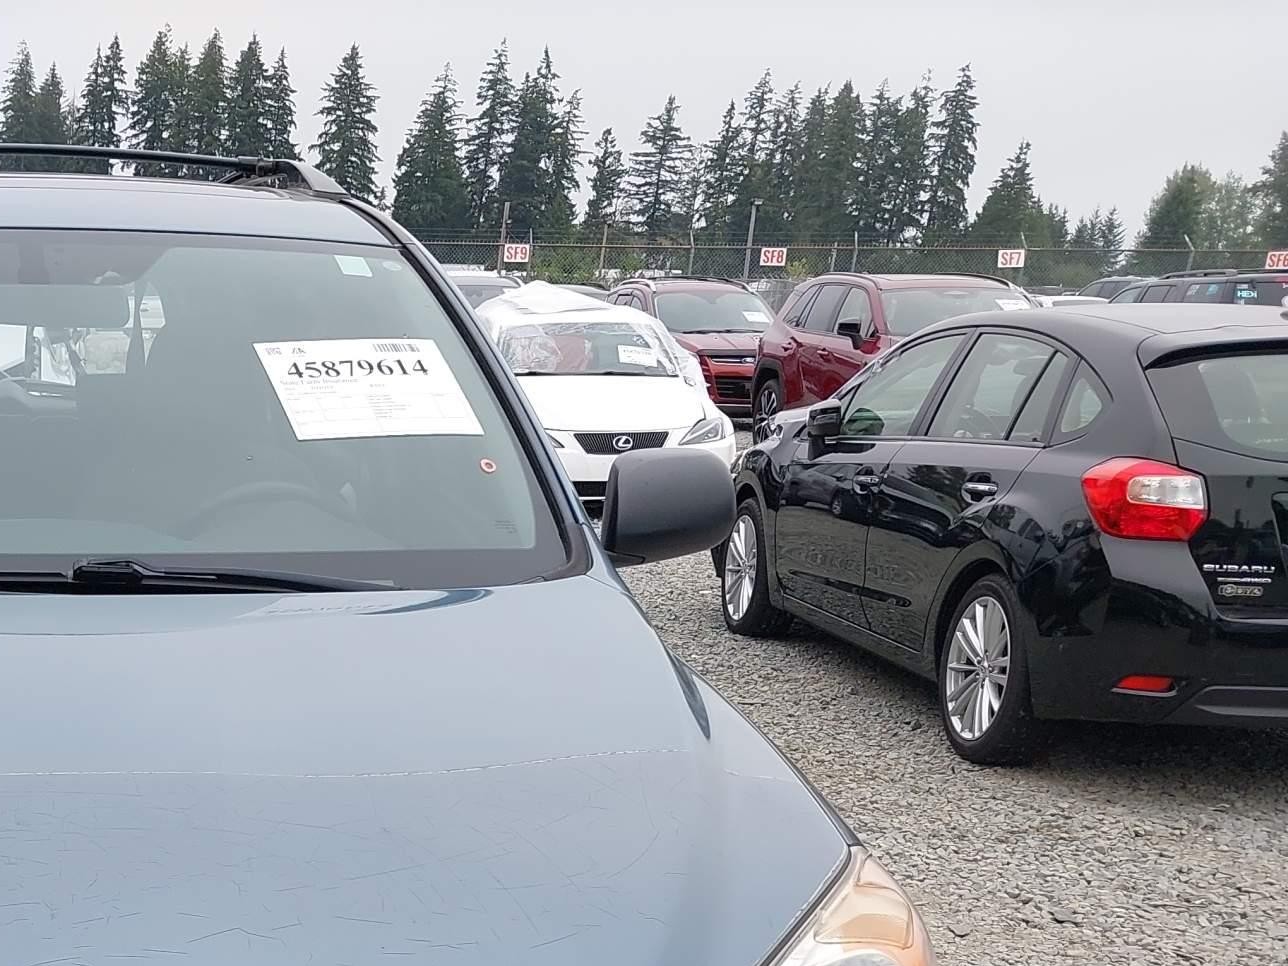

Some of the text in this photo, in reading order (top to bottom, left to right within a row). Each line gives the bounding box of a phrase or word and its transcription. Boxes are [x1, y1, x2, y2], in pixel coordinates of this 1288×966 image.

[506, 246, 527, 260] SF9
[763, 250, 784, 264] SF8
[1001, 251, 1022, 265] SF7
[288, 359, 429, 379] 45879614
[1203, 564, 1275, 573] SUBARU
